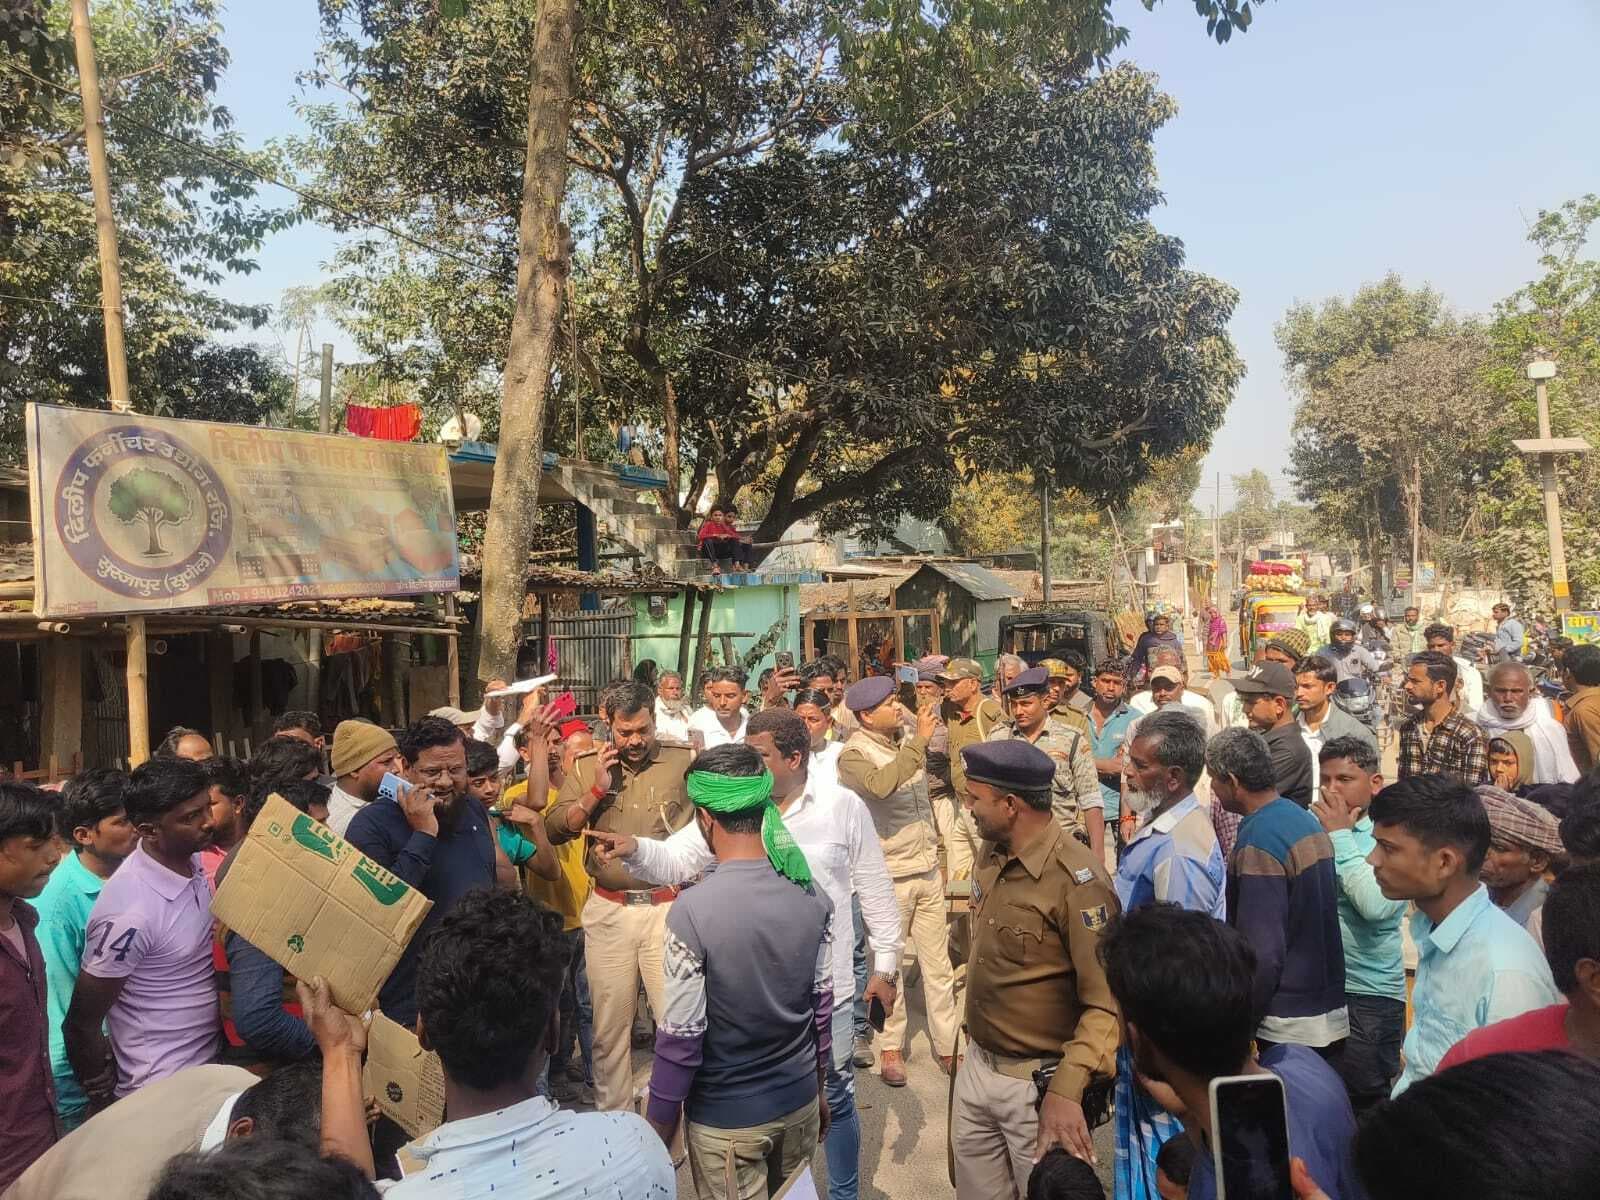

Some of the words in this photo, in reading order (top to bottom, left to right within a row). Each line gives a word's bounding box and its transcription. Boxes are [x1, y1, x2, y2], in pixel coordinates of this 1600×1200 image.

[62, 467, 90, 545] दिलीप
[82, 431, 157, 468] फर्नीचर
[88, 920, 137, 961] 14
